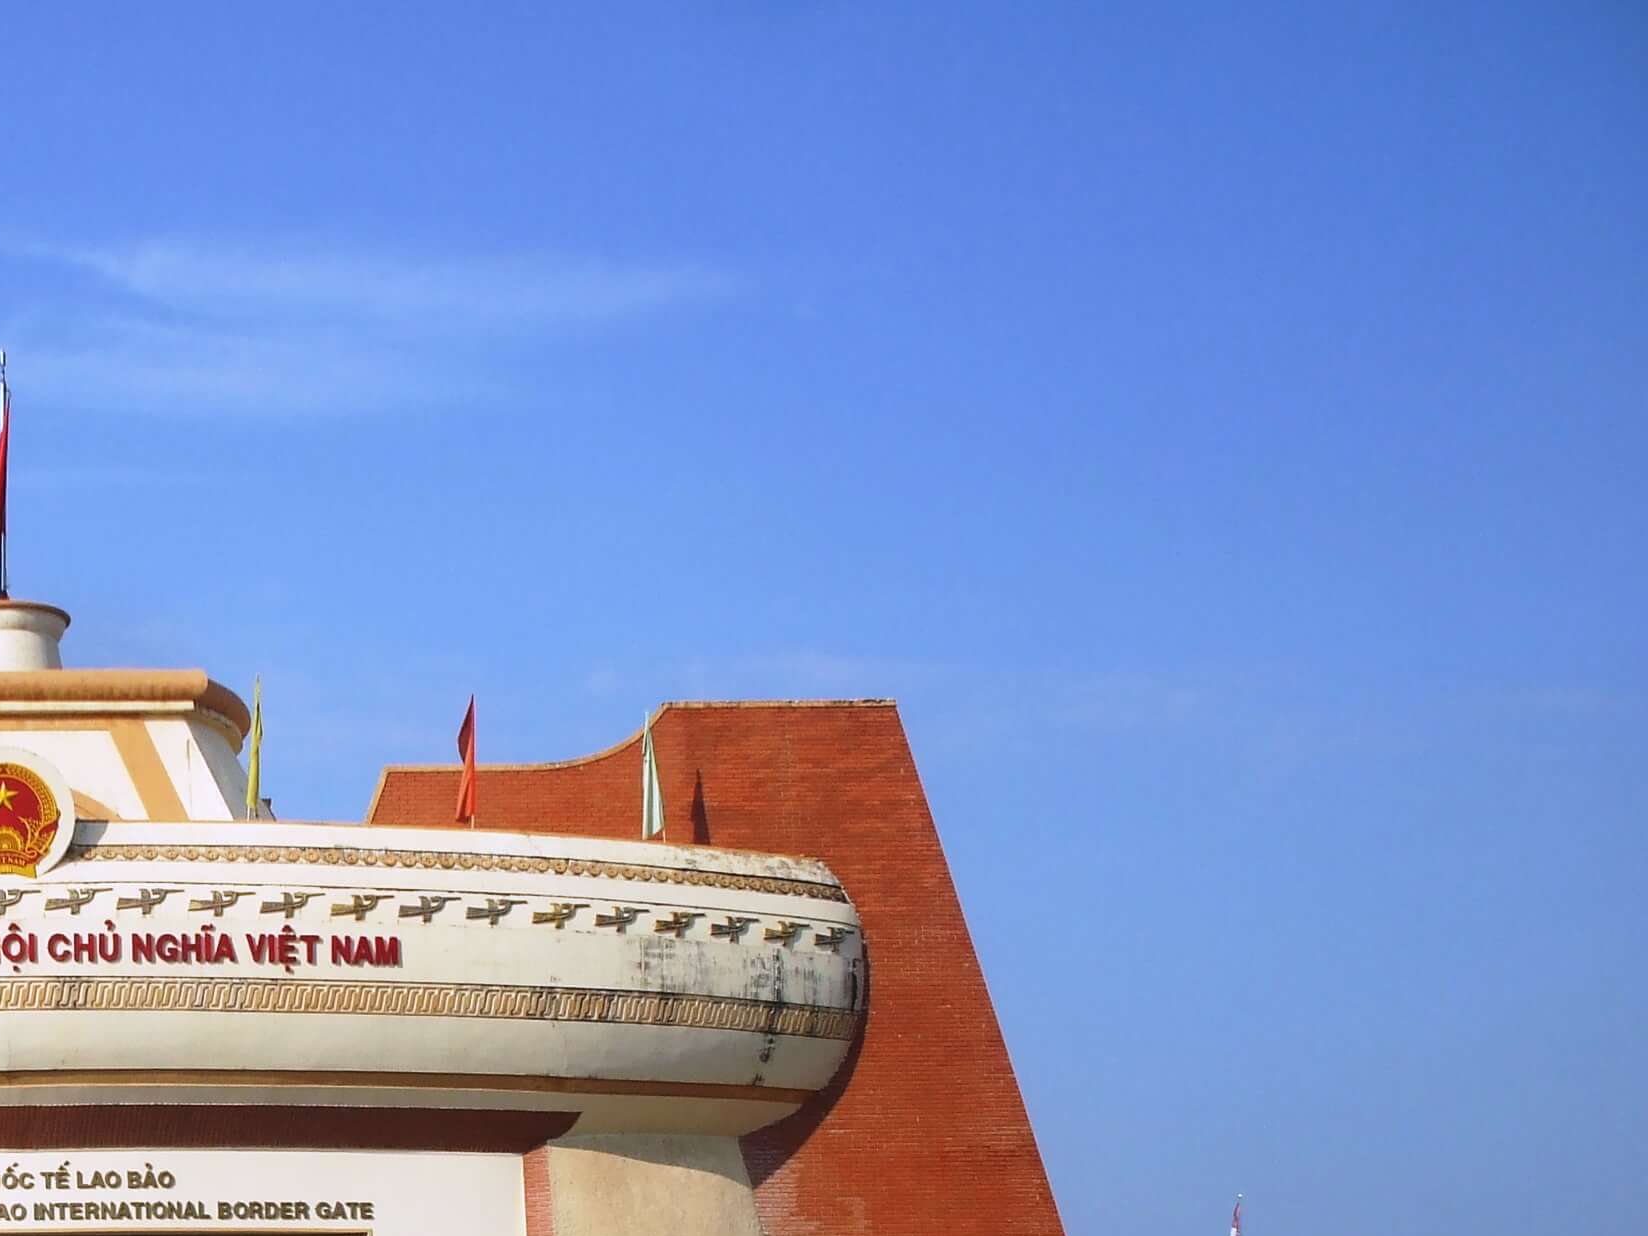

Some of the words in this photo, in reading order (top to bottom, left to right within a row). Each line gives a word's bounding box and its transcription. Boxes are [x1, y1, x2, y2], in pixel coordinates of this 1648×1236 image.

[47, 919, 121, 964] CHỦ
[131, 923, 239, 965] NGHĨA
[246, 924, 322, 974] VIỆT
[331, 935, 402, 968] NAM
[40, 1160, 72, 1190] TẾ
[76, 1170, 122, 1190] LAO
[33, 1200, 211, 1221] INTERNATIONAL
[217, 1200, 311, 1220] BORDER
[315, 1200, 374, 1220] GATE
